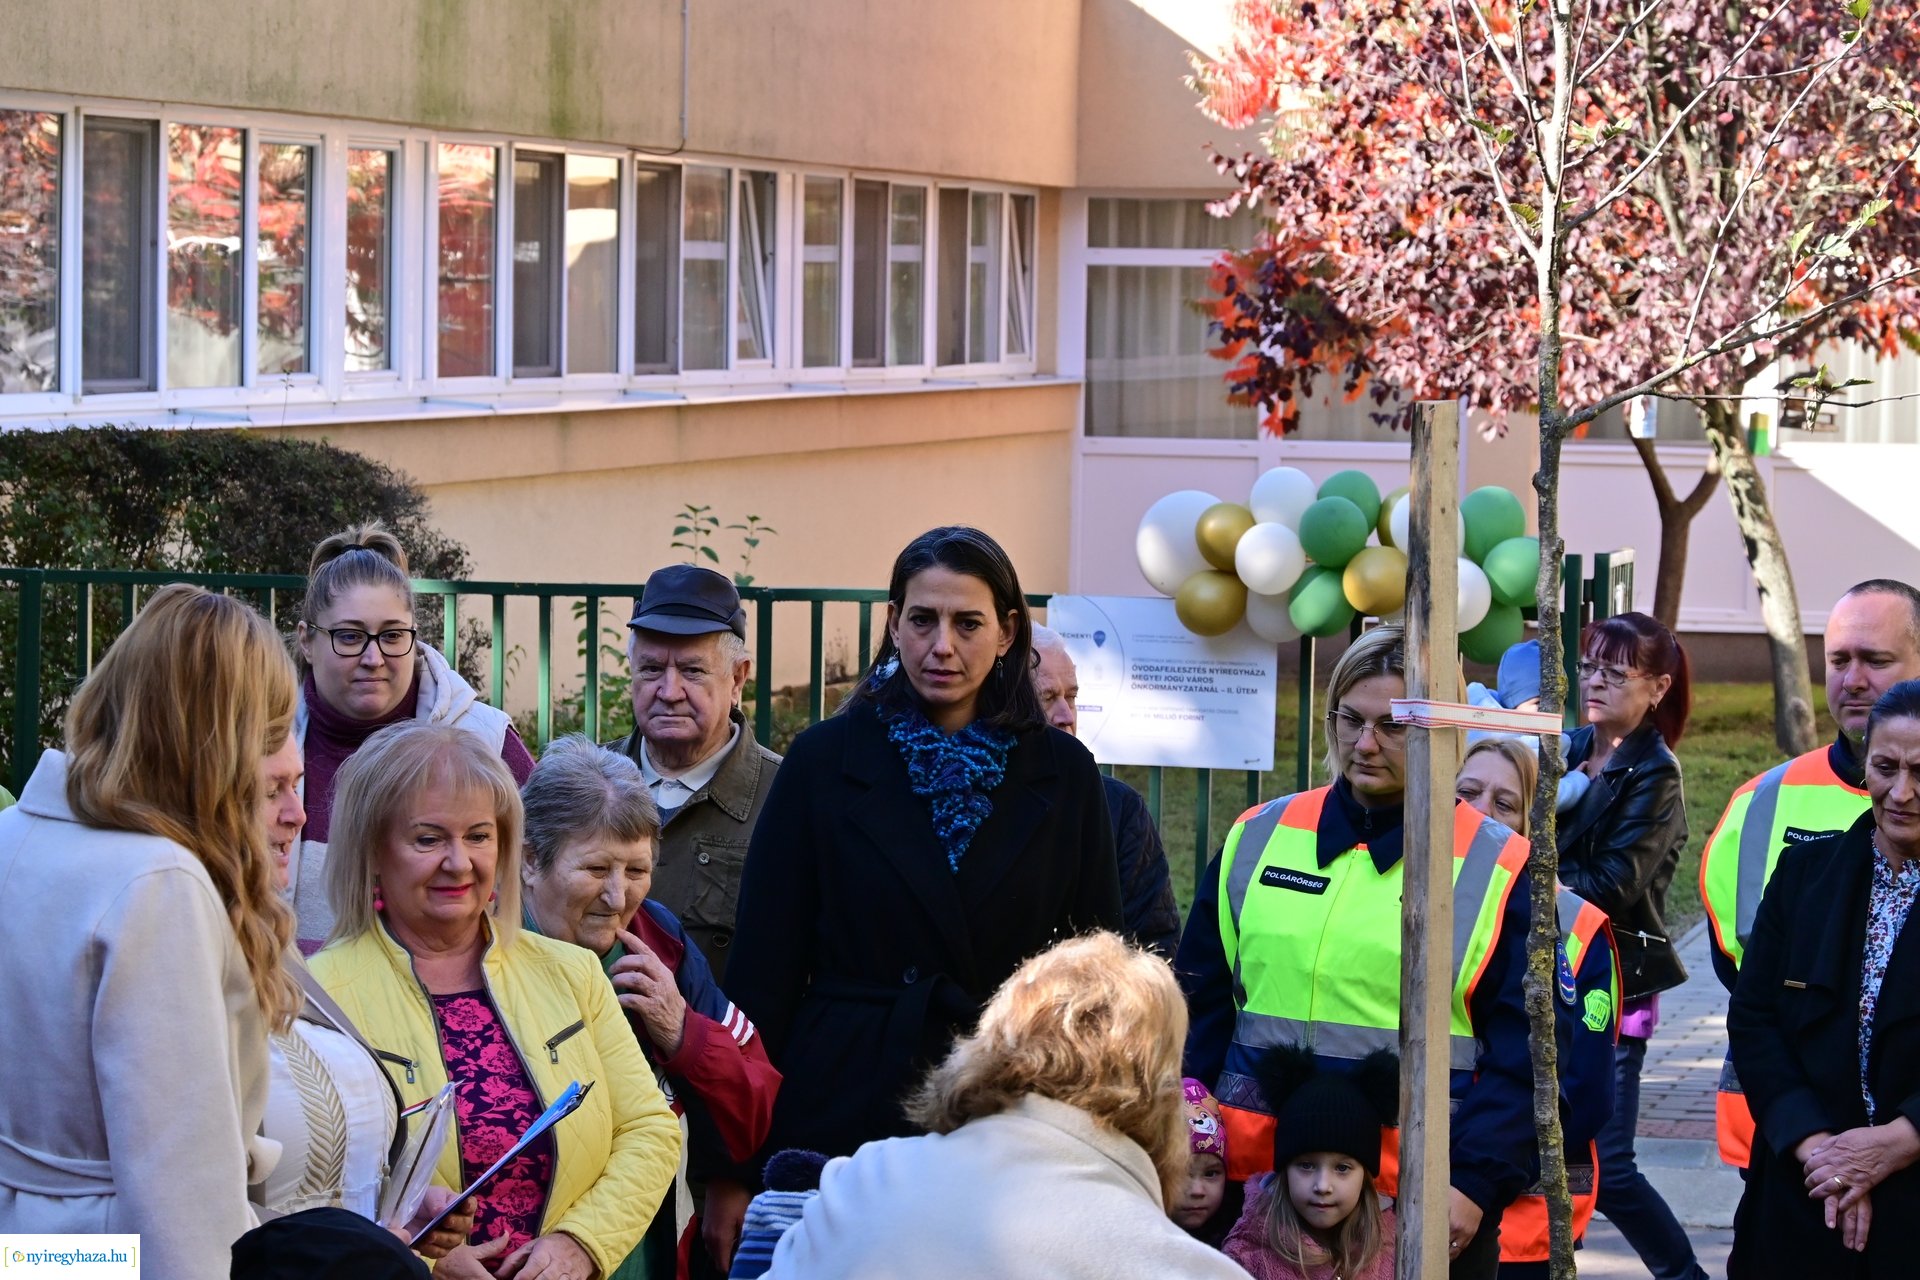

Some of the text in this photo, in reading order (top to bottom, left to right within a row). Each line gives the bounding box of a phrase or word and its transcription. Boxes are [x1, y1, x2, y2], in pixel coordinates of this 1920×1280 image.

[1132, 664, 1265, 676] ÓVODAFEJLESZTÉS NYÍREGYHÁZA
[1186, 675, 1214, 684] VÁROS
[1236, 686, 1258, 694] ÜTEM
[1264, 870, 1324, 888] POLGÁRŐRSÉG
